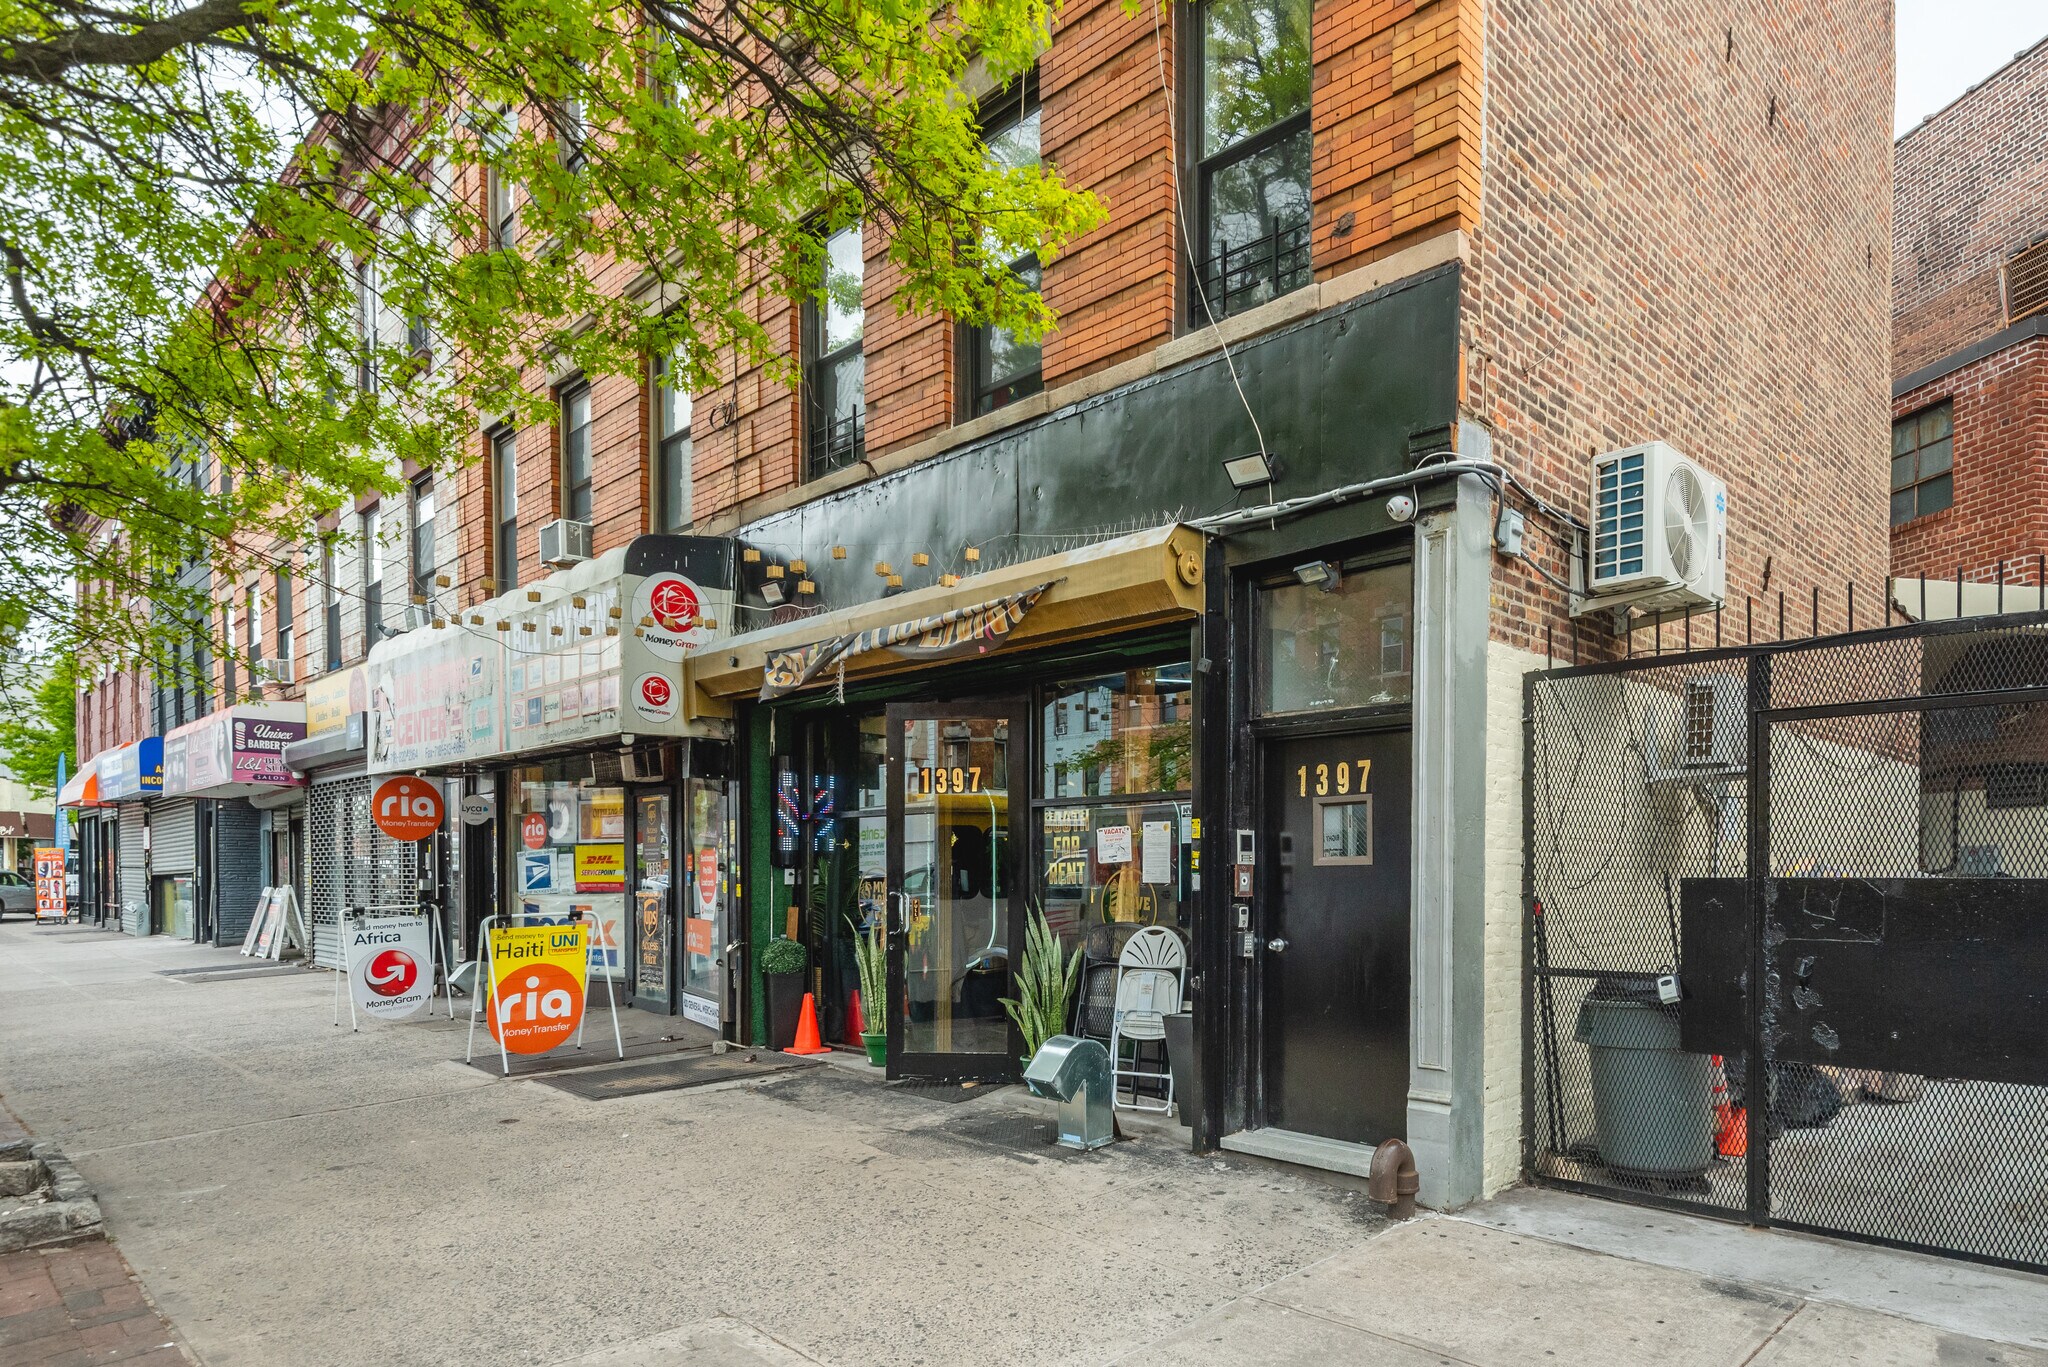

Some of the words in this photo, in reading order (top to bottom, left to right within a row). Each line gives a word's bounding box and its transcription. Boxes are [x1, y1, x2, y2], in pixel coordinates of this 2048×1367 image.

[638, 705, 671, 716] MoneyGram
[253, 723, 293, 740] Unisex
[398, 705, 447, 747] CENTER
[248, 739, 280, 750] BARBER
[236, 756, 262, 771] L&L
[921, 767, 982, 793] 1397
[1298, 760, 1371, 798] 1397
[381, 785, 435, 817] ria
[461, 804, 482, 815] Lyca
[381, 820, 407, 828] Money
[407, 820, 436, 828] Transfer
[525, 818, 545, 837] ria
[1054, 836, 1080, 859] FOR
[586, 856, 613, 864] DHL
[1049, 862, 1085, 884] RENT
[645, 911, 656, 925] ups
[353, 931, 402, 946] Africa
[551, 934, 579, 948] UNI
[642, 941, 658, 951] Access
[495, 941, 544, 960] Haiti
[643, 954, 656, 964] Point
[365, 995, 422, 1009] MoneyGram
[499, 976, 572, 1024] ria
[502, 1028, 532, 1038] Money
[533, 1022, 571, 1034] Transfer
